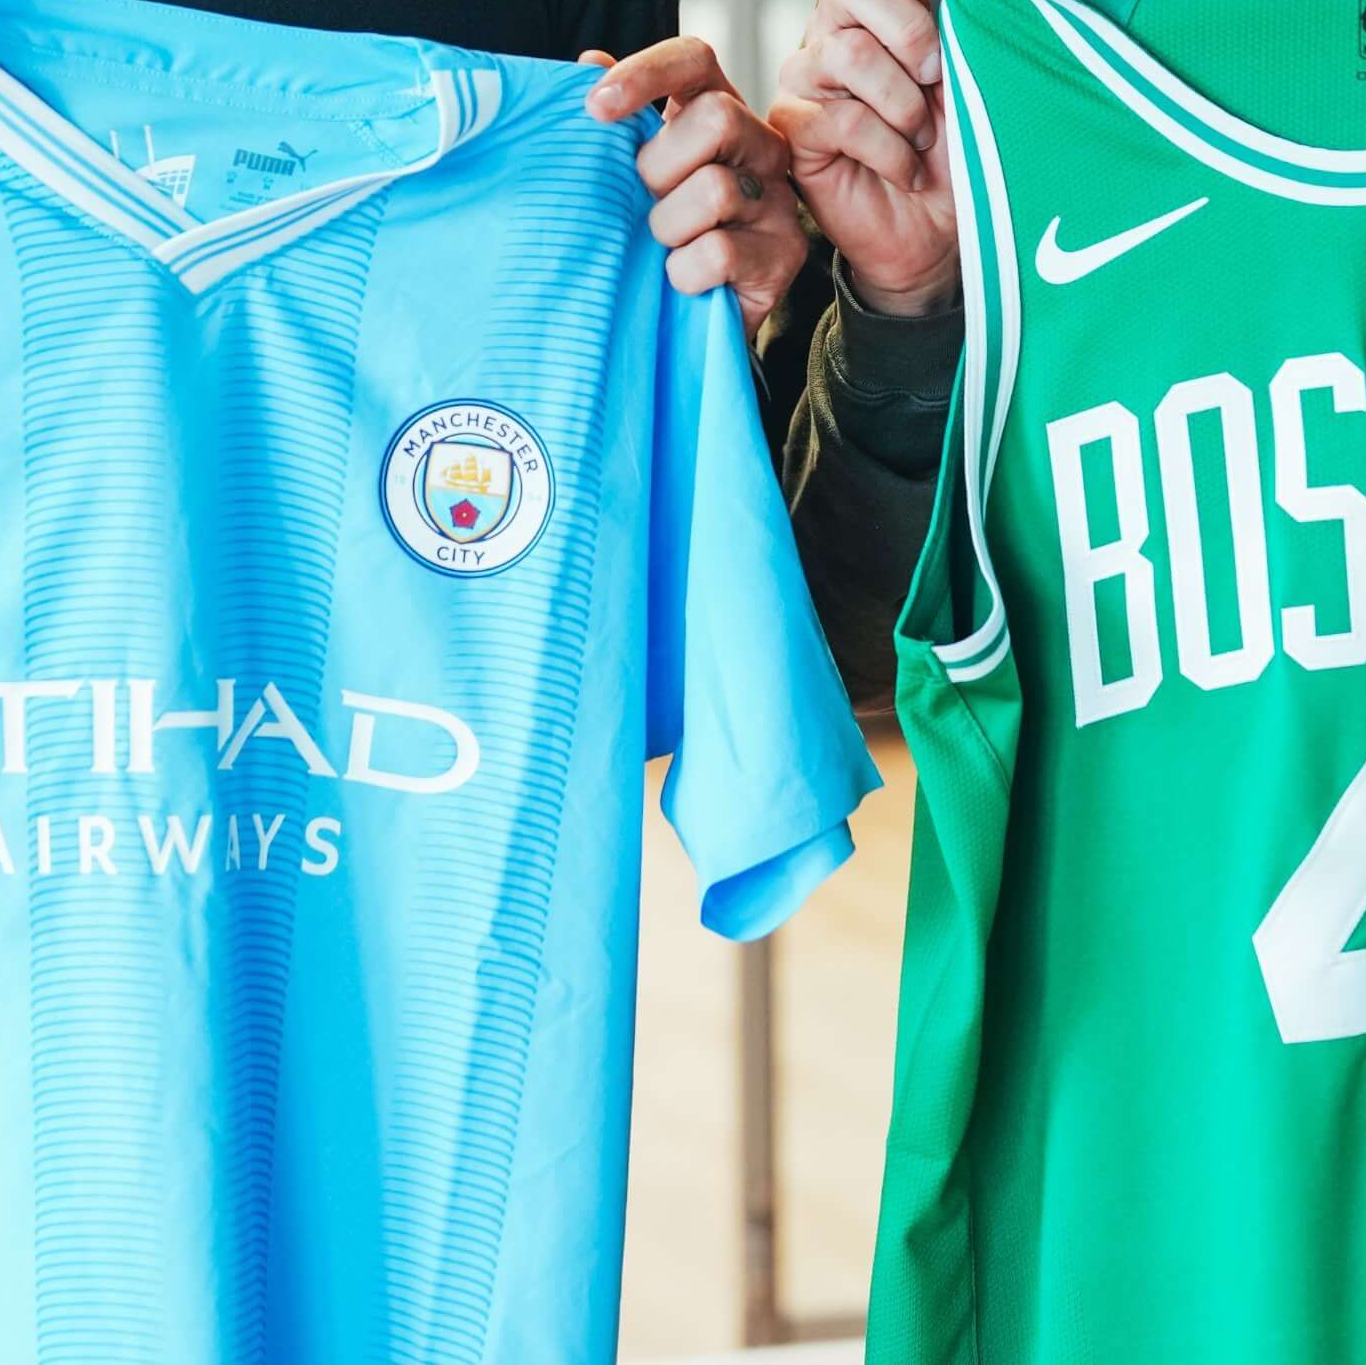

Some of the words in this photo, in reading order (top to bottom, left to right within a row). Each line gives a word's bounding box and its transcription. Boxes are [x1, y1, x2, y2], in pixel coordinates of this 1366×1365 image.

[233, 148, 296, 176] PUMA
[403, 412, 539, 474] MANCHESTER
[436, 546, 485, 565] CITY
